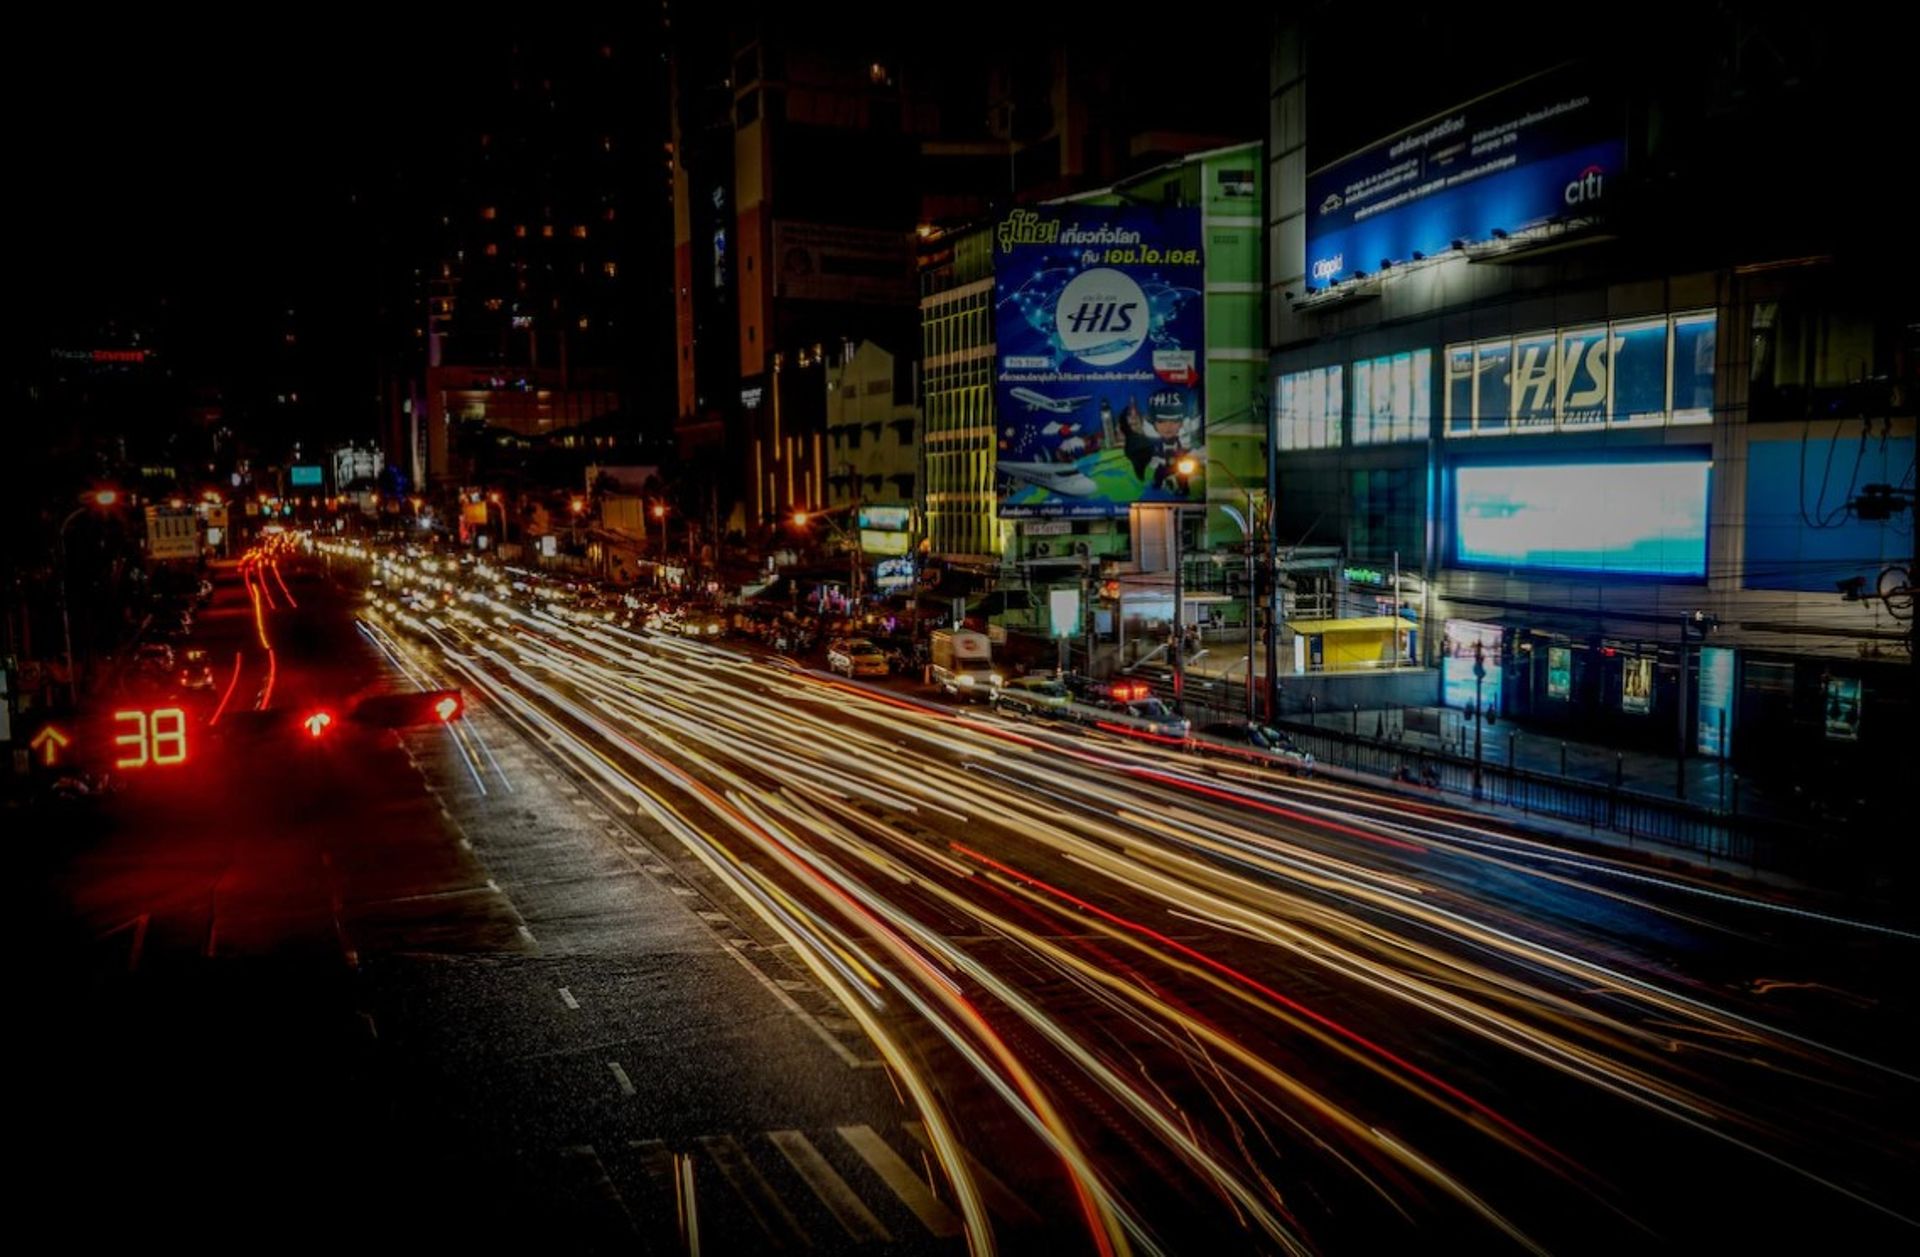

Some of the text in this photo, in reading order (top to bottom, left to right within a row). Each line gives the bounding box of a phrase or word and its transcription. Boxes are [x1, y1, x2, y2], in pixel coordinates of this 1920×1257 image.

[1565, 173, 1603, 205] citi
[1060, 222, 1141, 245] เที่ยวทั่วโลก
[1081, 249, 1100, 264] กับ
[1069, 303, 1137, 332] HIS
[114, 708, 187, 769] 38
